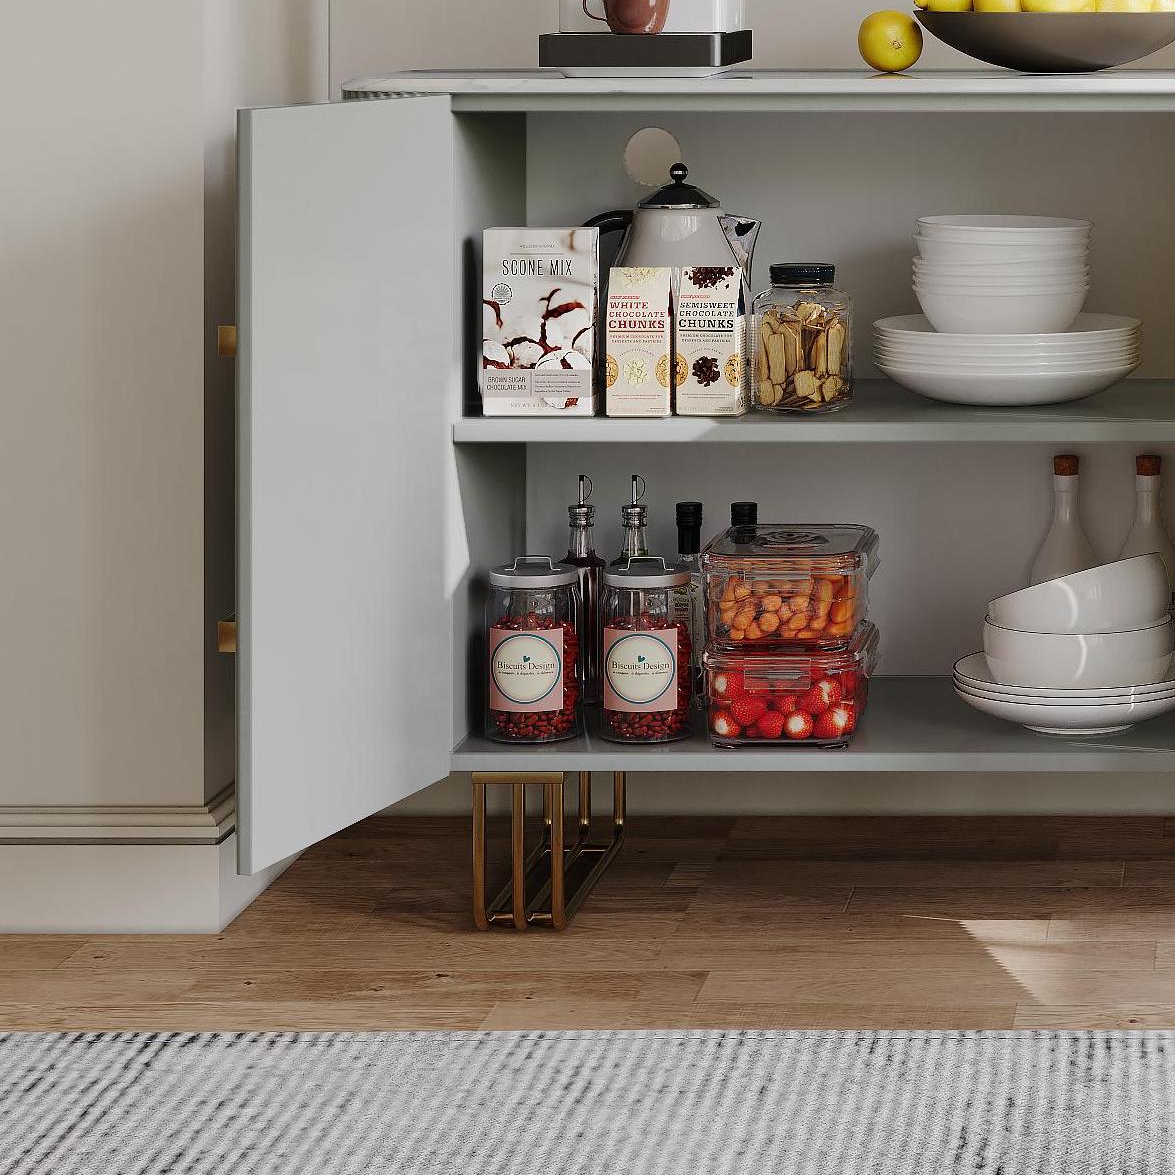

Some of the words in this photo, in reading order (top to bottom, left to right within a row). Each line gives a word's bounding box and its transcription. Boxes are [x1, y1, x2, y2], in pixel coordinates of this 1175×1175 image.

[502, 259, 544, 276] SCONE
[550, 259, 573, 276] MIX
[610, 301, 649, 309] WHITE
[608, 320, 665, 329] CHUNKS
[678, 319, 734, 329] CHUNKS
[497, 661, 526, 671] Biscuits
[528, 661, 555, 671] Design
[612, 661, 642, 670] Biscuits
[643, 662, 670, 671] Design
